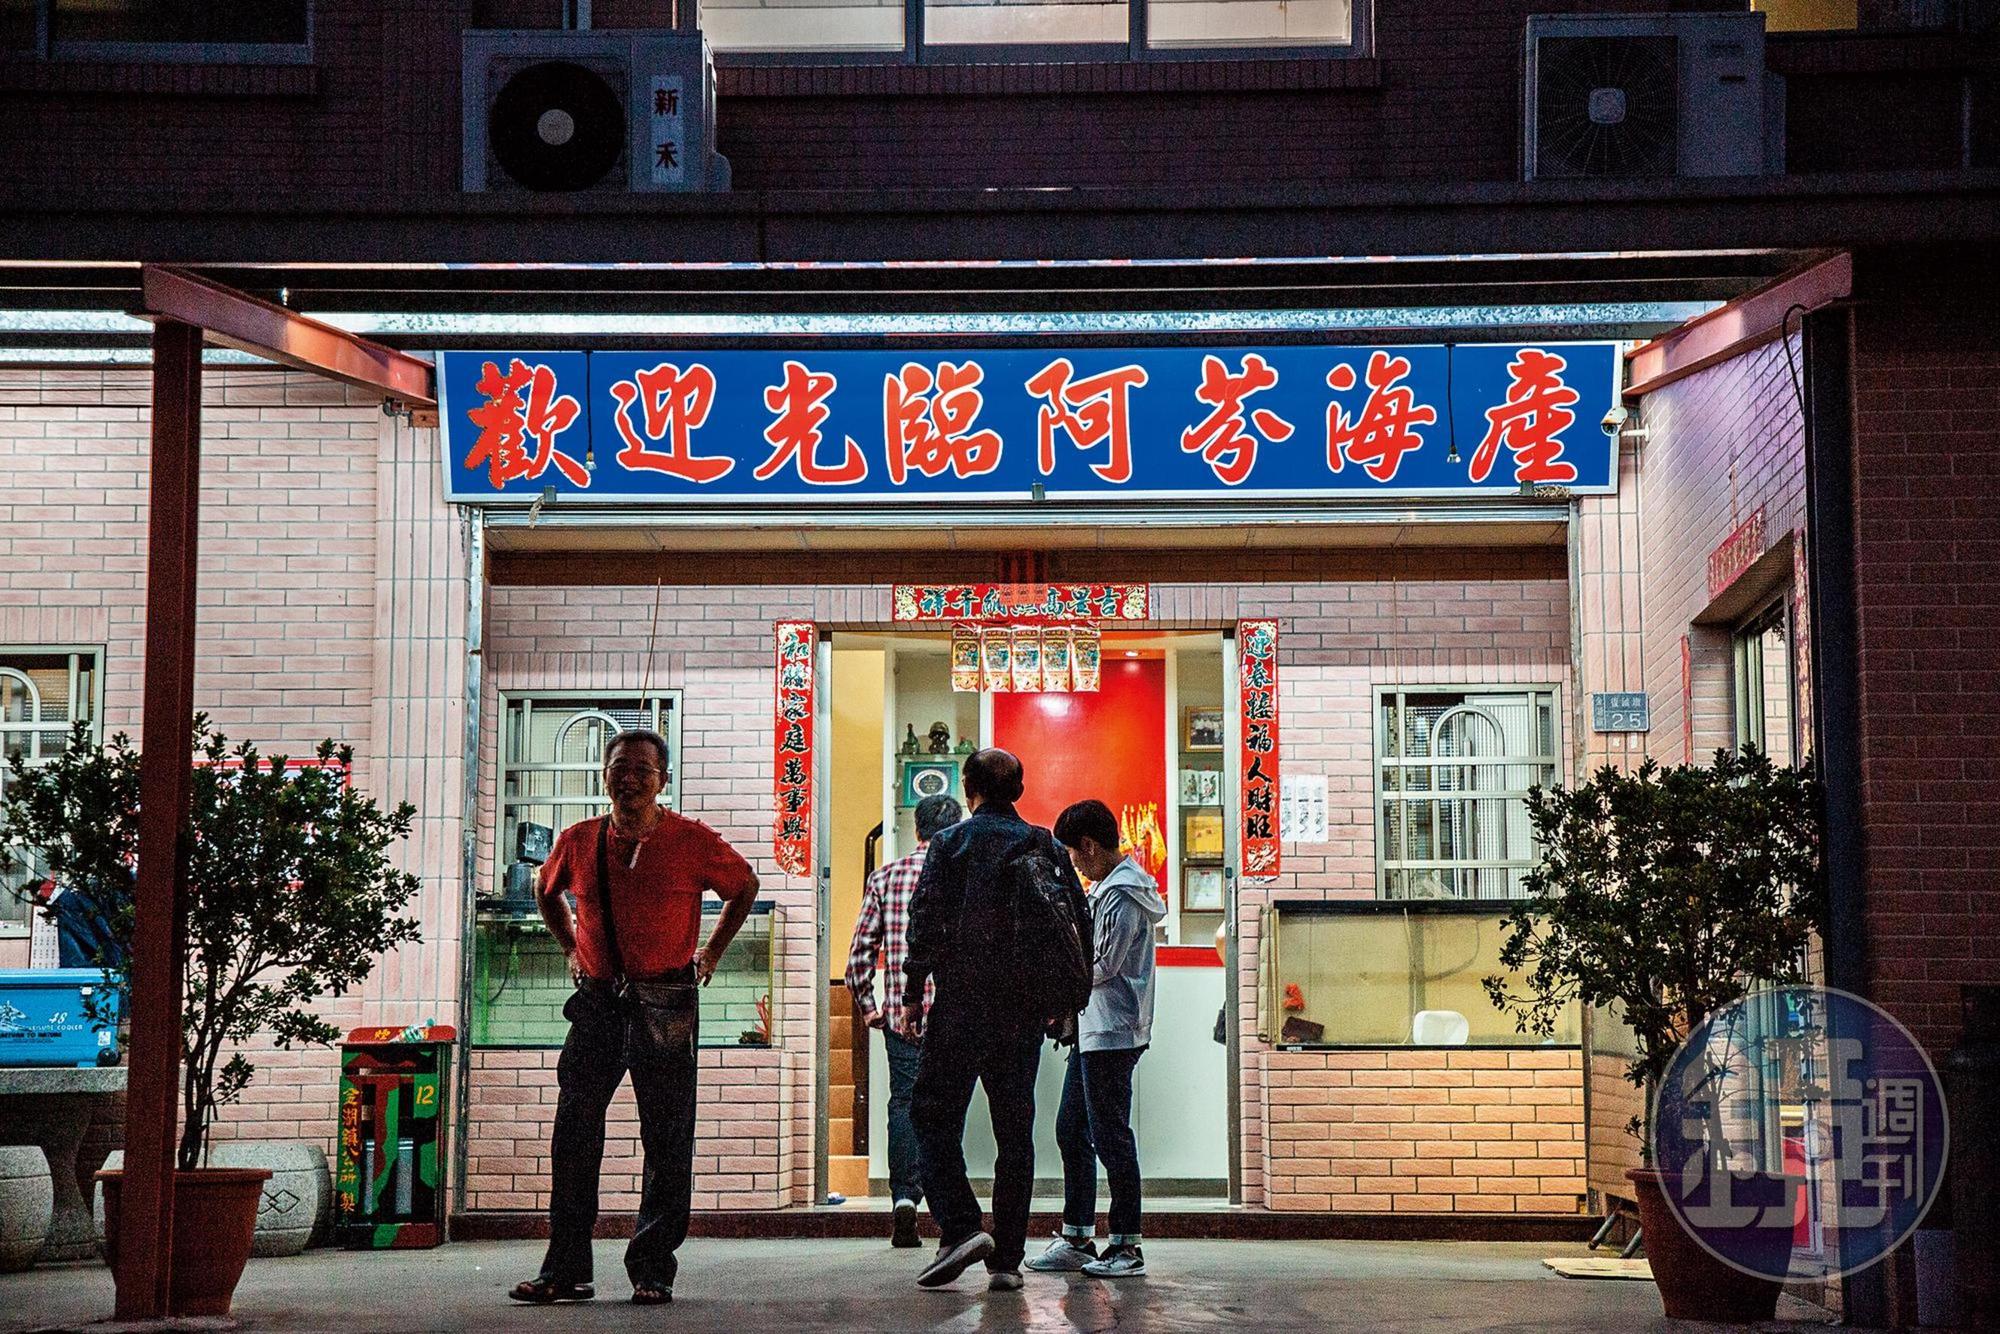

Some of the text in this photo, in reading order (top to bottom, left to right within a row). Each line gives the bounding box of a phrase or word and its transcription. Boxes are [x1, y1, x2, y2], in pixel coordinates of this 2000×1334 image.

[465, 348, 1580, 489] 歡迎光臨阿芬海產
[1245, 629, 1274, 839] 迎春接福人財旺
[1611, 713, 1641, 728] 25
[416, 1084, 435, 1105] 12
